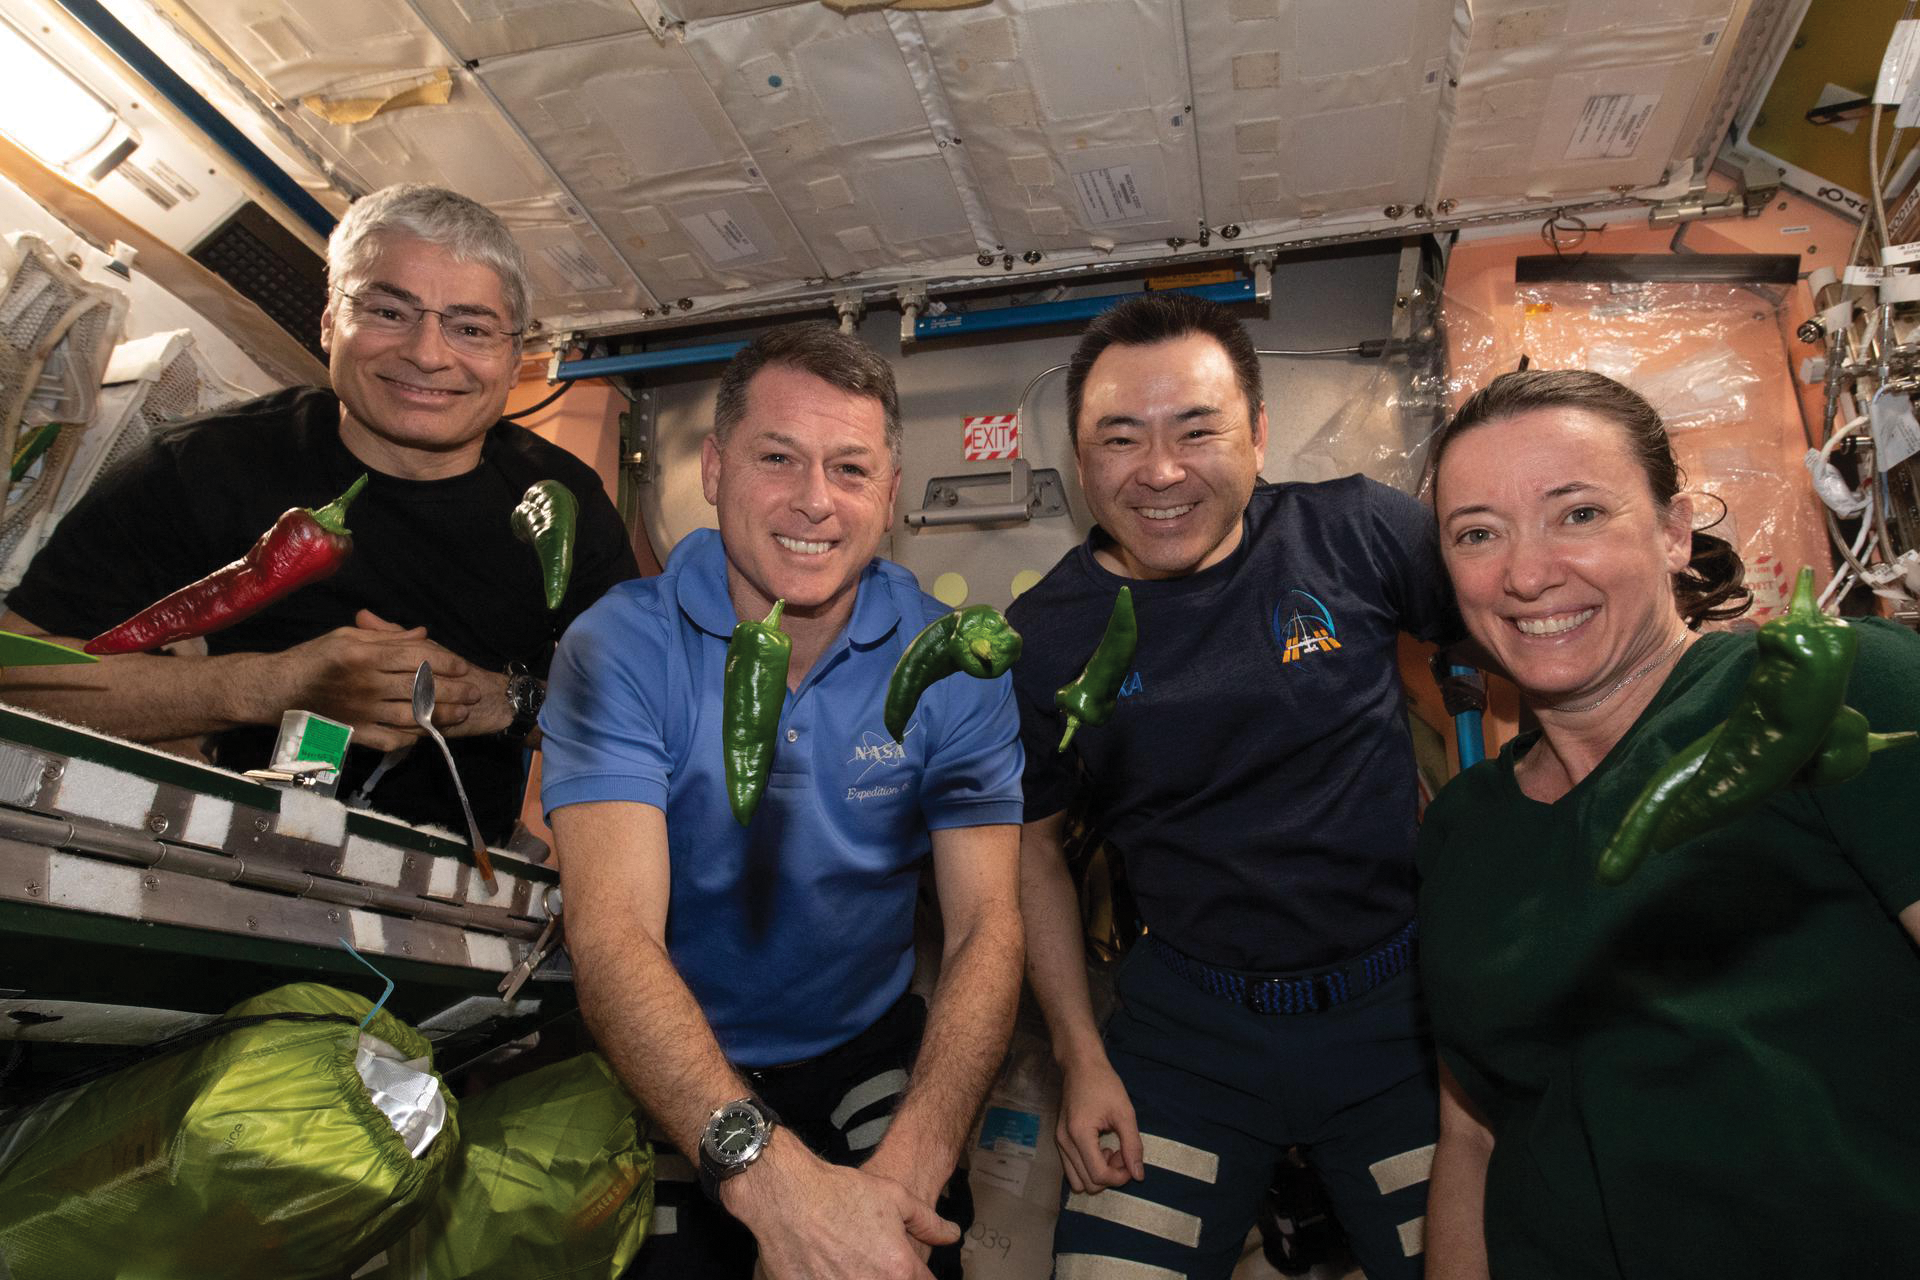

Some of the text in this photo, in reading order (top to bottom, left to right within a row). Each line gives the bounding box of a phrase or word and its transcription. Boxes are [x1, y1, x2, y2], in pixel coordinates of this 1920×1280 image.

[972, 426, 1009, 449] EXIT
[1117, 672, 1143, 698] XA
[855, 744, 906, 760] NASA
[847, 785, 899, 802] Expedition
[224, 1123, 245, 1147] ice
